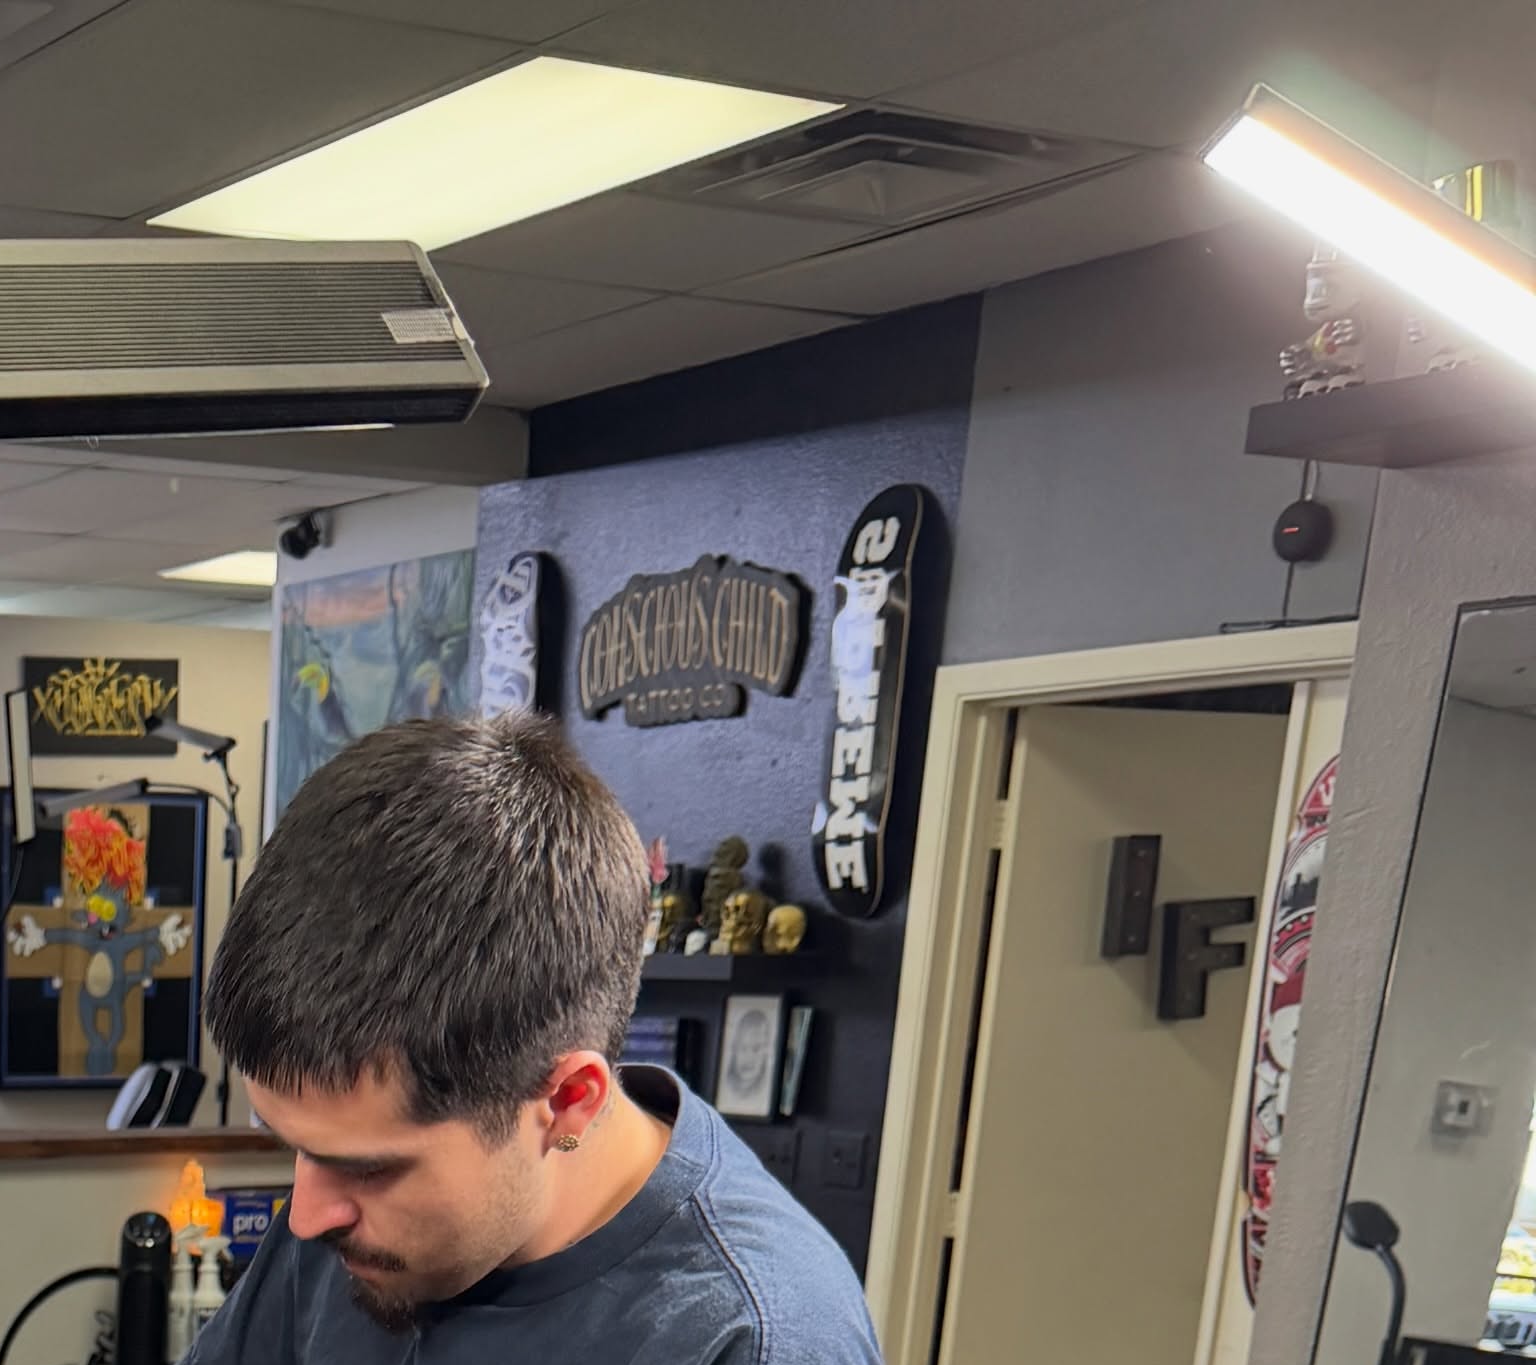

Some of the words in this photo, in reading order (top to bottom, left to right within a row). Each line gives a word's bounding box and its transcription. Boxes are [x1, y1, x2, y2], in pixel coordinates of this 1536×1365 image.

[580, 571, 709, 710] CONSCIOUS
[712, 577, 789, 685] CHILD
[232, 1213, 269, 1234] pro
